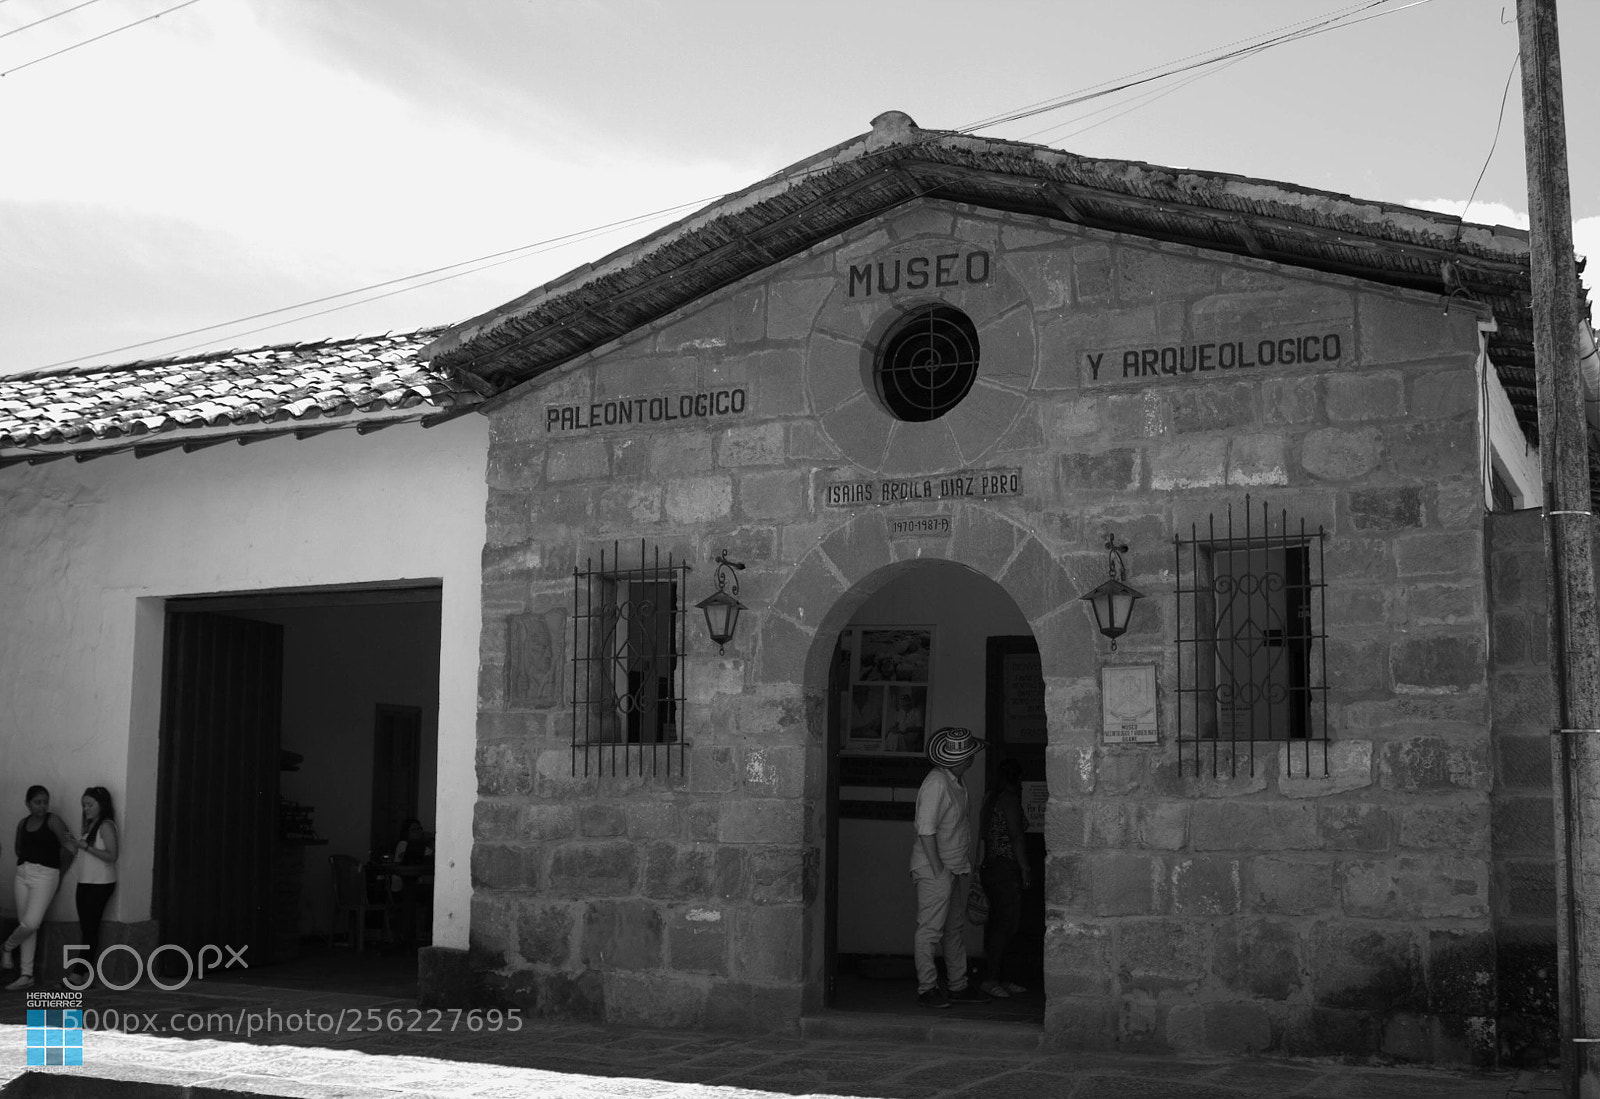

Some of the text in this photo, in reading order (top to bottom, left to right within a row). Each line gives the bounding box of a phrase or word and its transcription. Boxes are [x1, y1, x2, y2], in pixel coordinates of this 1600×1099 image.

[849, 250, 990, 298] MUSEO
[1086, 333, 1342, 380] Y ARQUEOLOGICO
[546, 388, 746, 433] PALEONTOLOGICO
[828, 474, 1018, 504] ISAIAS ARDILA DIAZ PBRO
